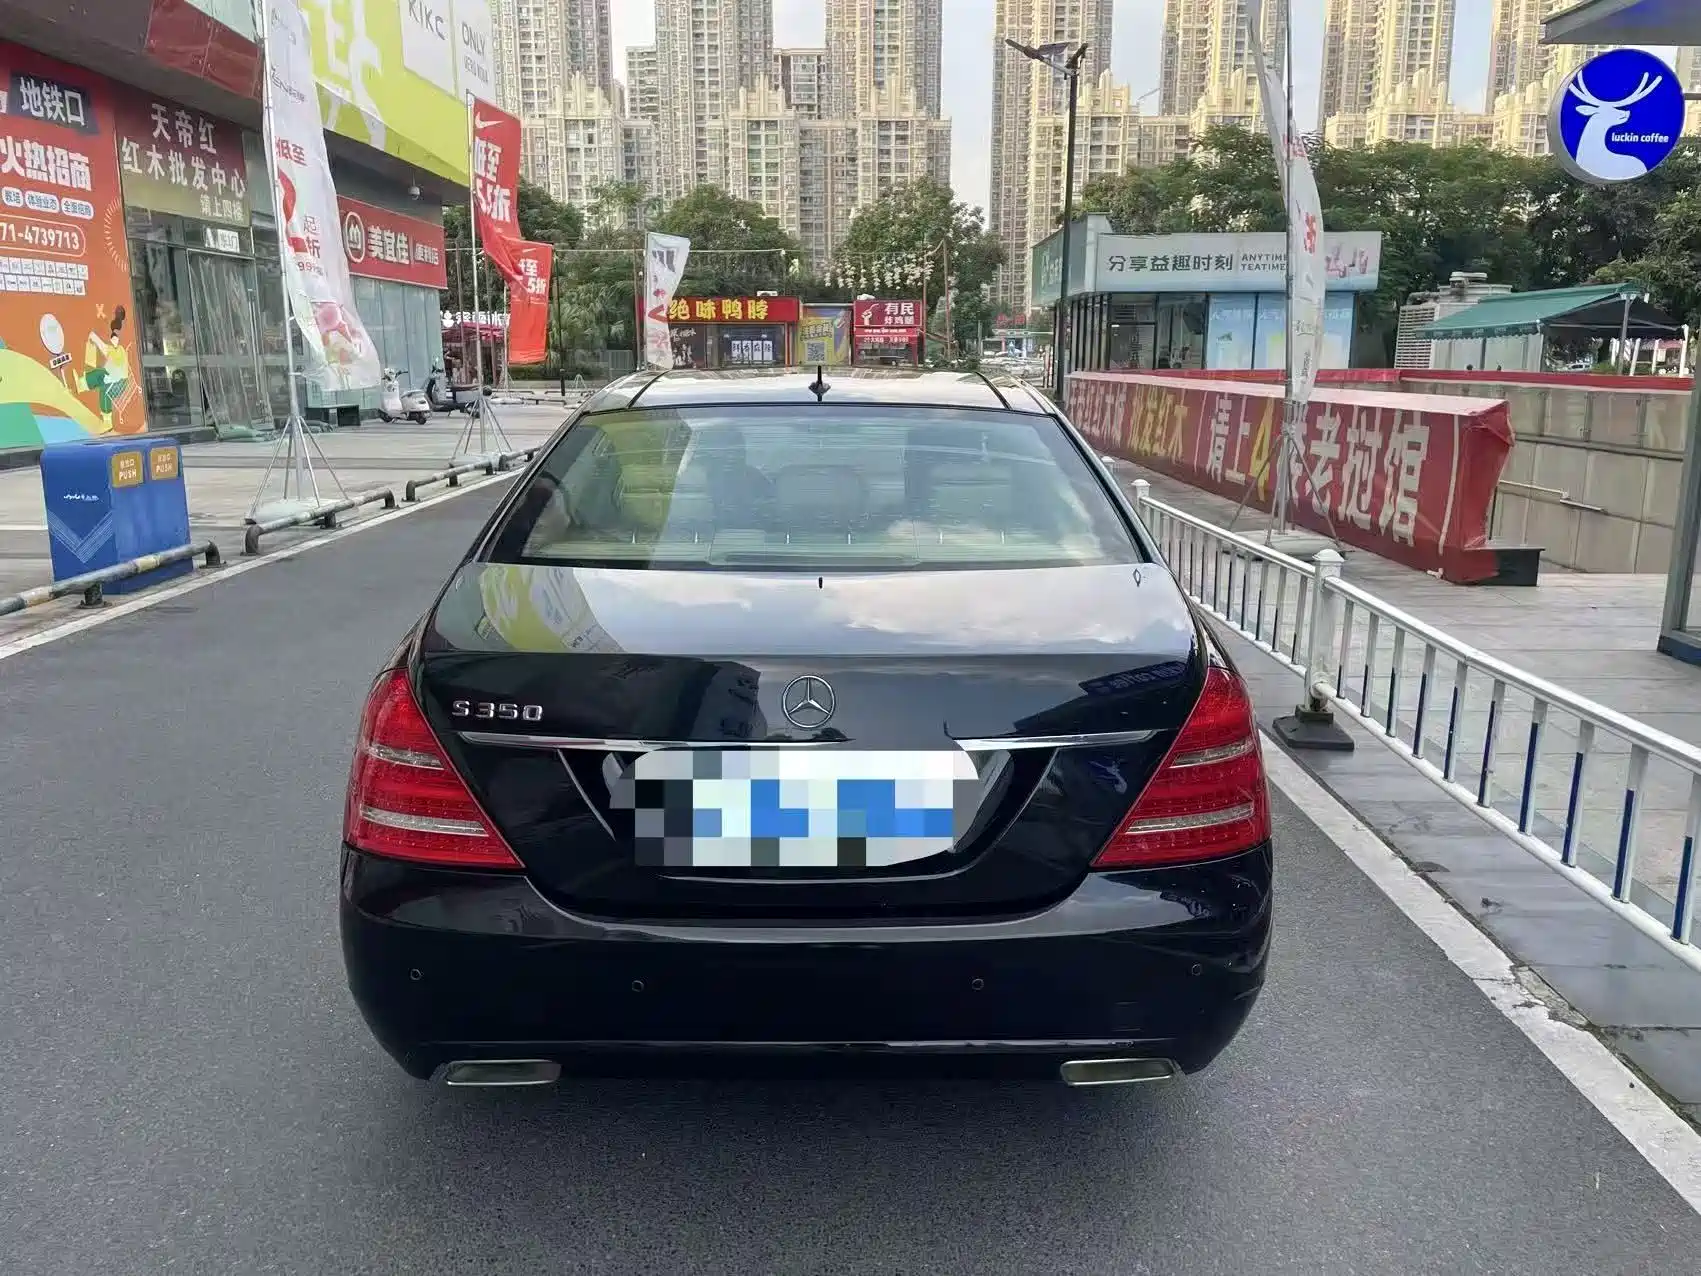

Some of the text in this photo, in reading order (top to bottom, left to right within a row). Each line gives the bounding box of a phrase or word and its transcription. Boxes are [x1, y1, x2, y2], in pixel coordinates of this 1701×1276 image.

[462, 20, 486, 57] ONLY
[20, 77, 85, 127] 地铁口
[151, 103, 217, 154] 天帝红
[1611, 132, 1669, 143] luckin coffee
[0, 136, 92, 191] 火热招商
[121, 137, 246, 198] 红木批发中心
[368, 225, 410, 265] 美宜佳
[1108, 254, 1233, 273] 分享益趣时刻
[1241, 263, 1287, 271] TEATIME
[669, 298, 768, 320] 绝味鸭脖
[884, 302, 914, 315] 有民
[119, 469, 137, 481] PUSH
